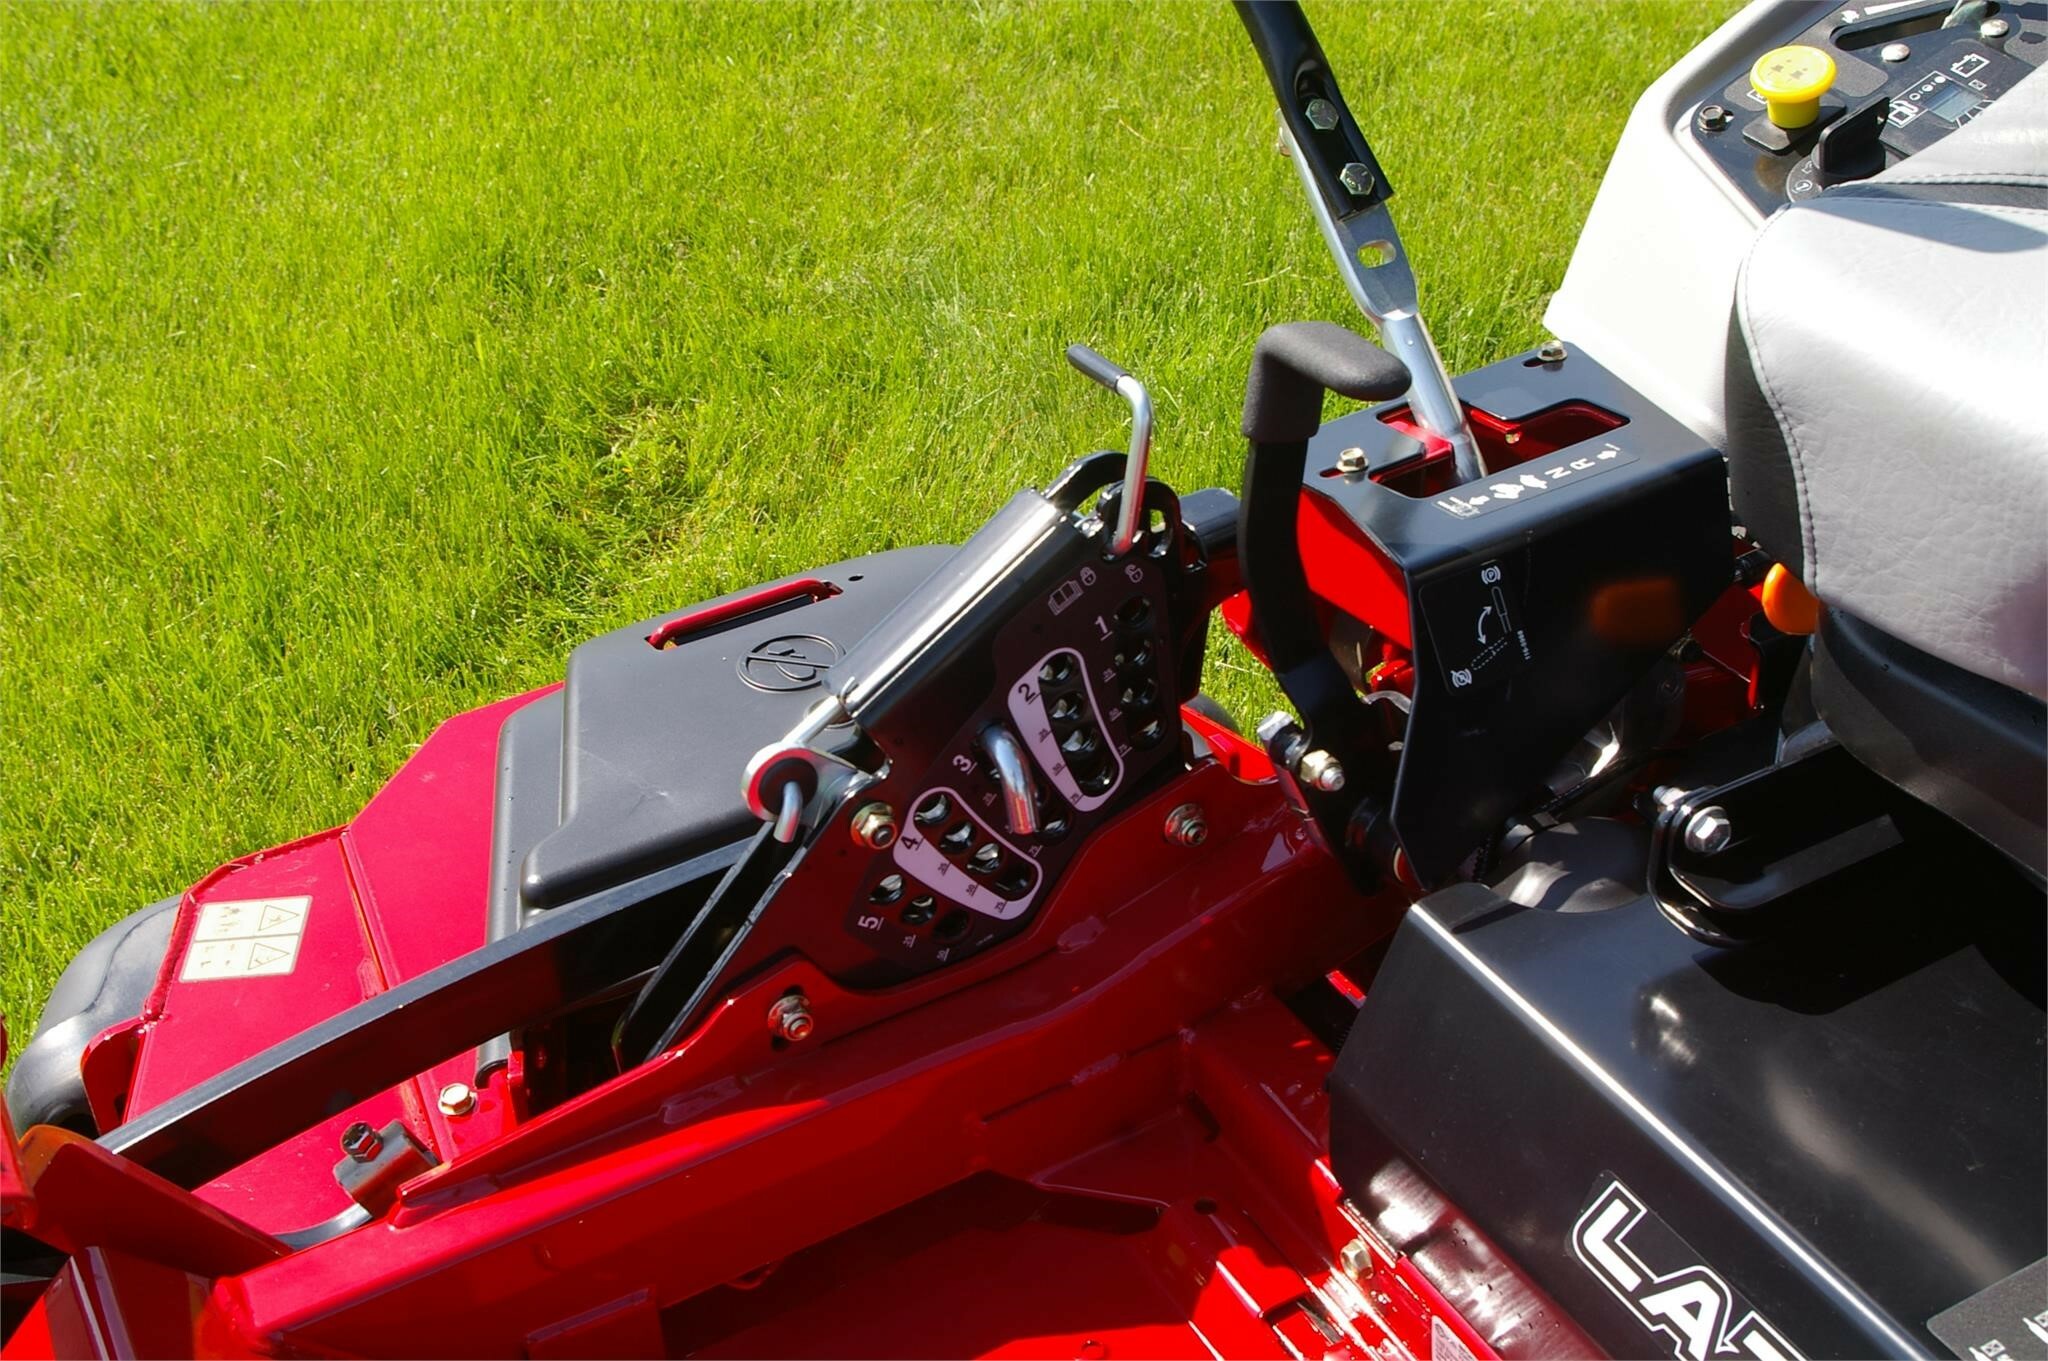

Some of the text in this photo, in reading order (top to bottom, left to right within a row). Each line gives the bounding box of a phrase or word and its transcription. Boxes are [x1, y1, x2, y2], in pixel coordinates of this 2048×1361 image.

[1569, 458, 1596, 470] R
[1095, 616, 1109, 635] 1
[1018, 683, 1036, 702] 2
[952, 755, 971, 771] 3
[901, 836, 919, 850] 4
[857, 915, 879, 929] 5
[1574, 1181, 1806, 1361] LA
